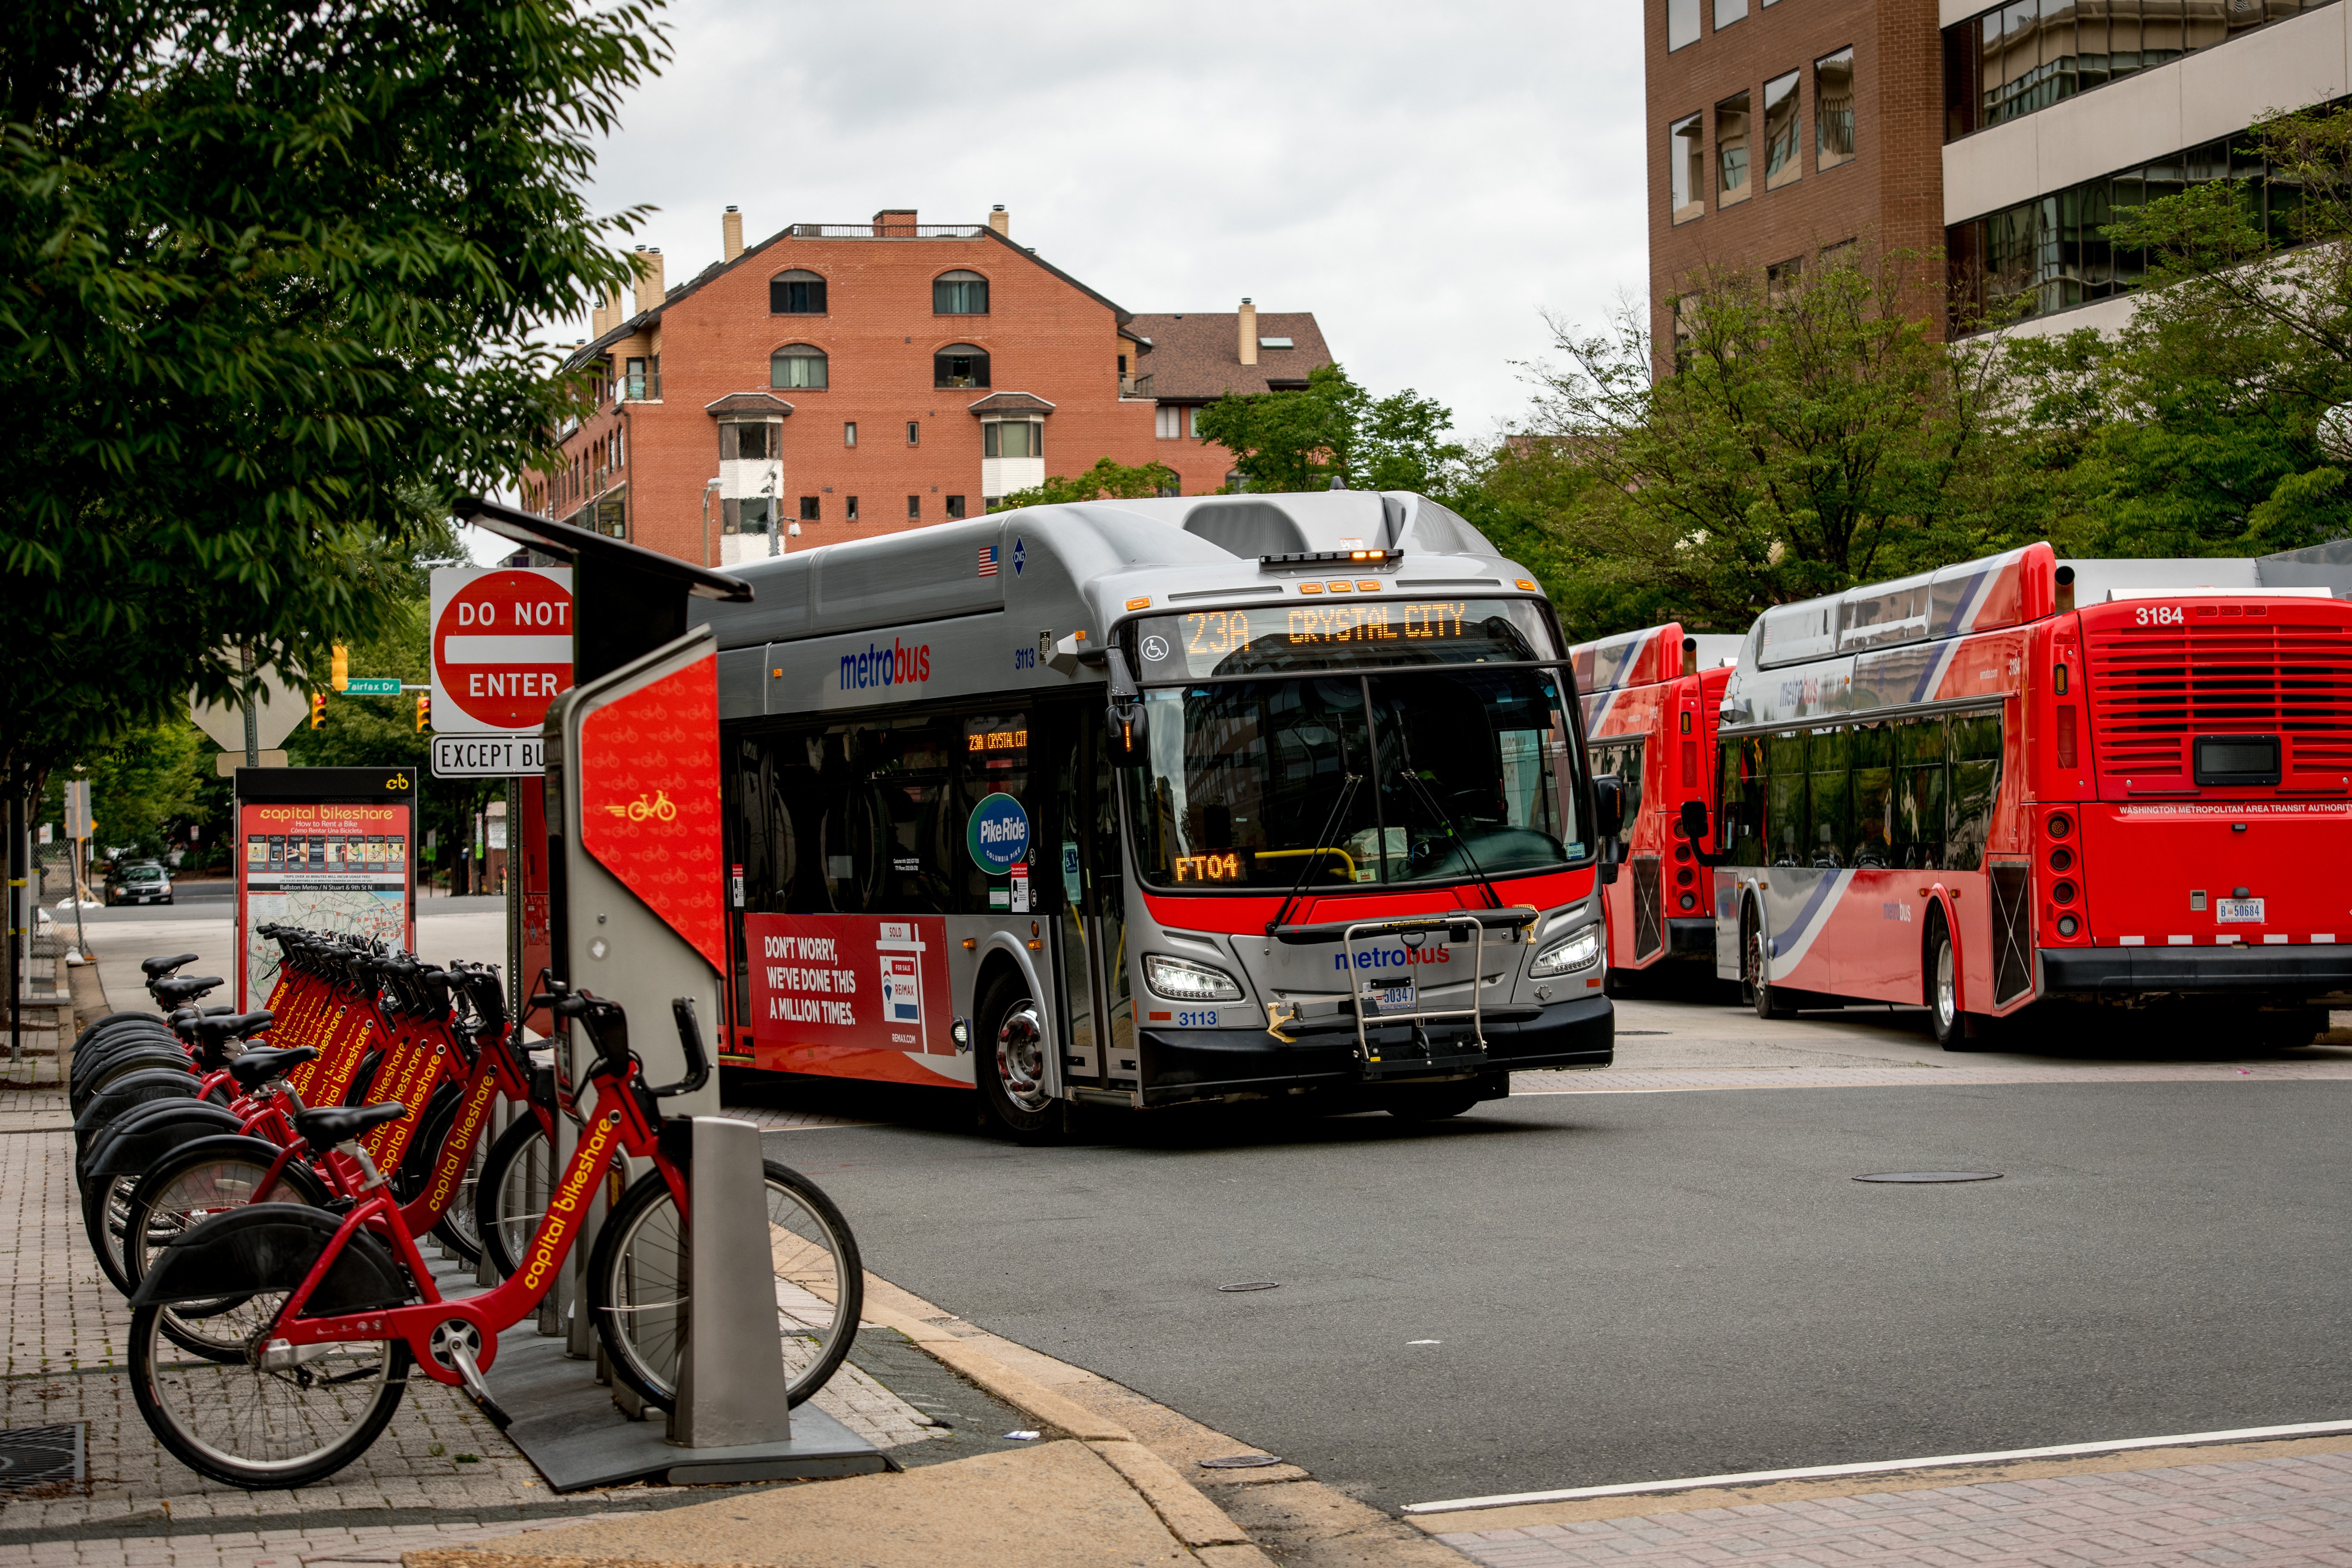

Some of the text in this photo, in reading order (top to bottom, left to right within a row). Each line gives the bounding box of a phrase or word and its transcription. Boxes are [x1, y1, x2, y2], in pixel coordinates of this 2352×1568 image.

[1014, 551, 1024, 562] CNG
[459, 602, 569, 626] DO NOT
[2135, 606, 2184, 625] 3184
[1188, 603, 1465, 654] 23A CRYSTAL CITY
[840, 637, 930, 690] metrobus
[1015, 648, 1034, 670] 3113
[2009, 657, 2020, 676] 3184
[348, 682, 379, 690] Fairfax
[470, 673, 557, 697] ENTER
[1980, 668, 1997, 680] wmata.com
[1780, 672, 1818, 707] metrobus
[1015, 731, 1027, 746] CIT
[442, 744, 512, 767] EXCEPT
[260, 804, 393, 822] capital bikeshare
[986, 846, 1021, 862] COLUMBIA PIKE
[1176, 853, 1238, 881] FT04
[1884, 898, 1911, 922] metrobus
[2221, 905, 2259, 917] B 50684
[889, 927, 902, 937] SOLD
[797, 937, 837, 966] WORRY,
[801, 968, 831, 992] DONE
[832, 970, 856, 993] THIS
[895, 984, 914, 996] RE/MAX
[269, 982, 289, 1013] eshare
[1385, 987, 1414, 1003] 50347
[770, 997, 856, 1025] A MILLION TIMES.
[1179, 1011, 1217, 1026] 3113
[892, 1034, 916, 1044] REMAX.COM
[333, 1026, 370, 1083] bikeshare
[297, 1063, 316, 1096] apital
[368, 1042, 408, 1104] bikeshare
[367, 1047, 425, 1156] apita ikeshare
[429, 1074, 494, 1212] capital bikeshare
[525, 1118, 613, 1290] capital bikeshare
